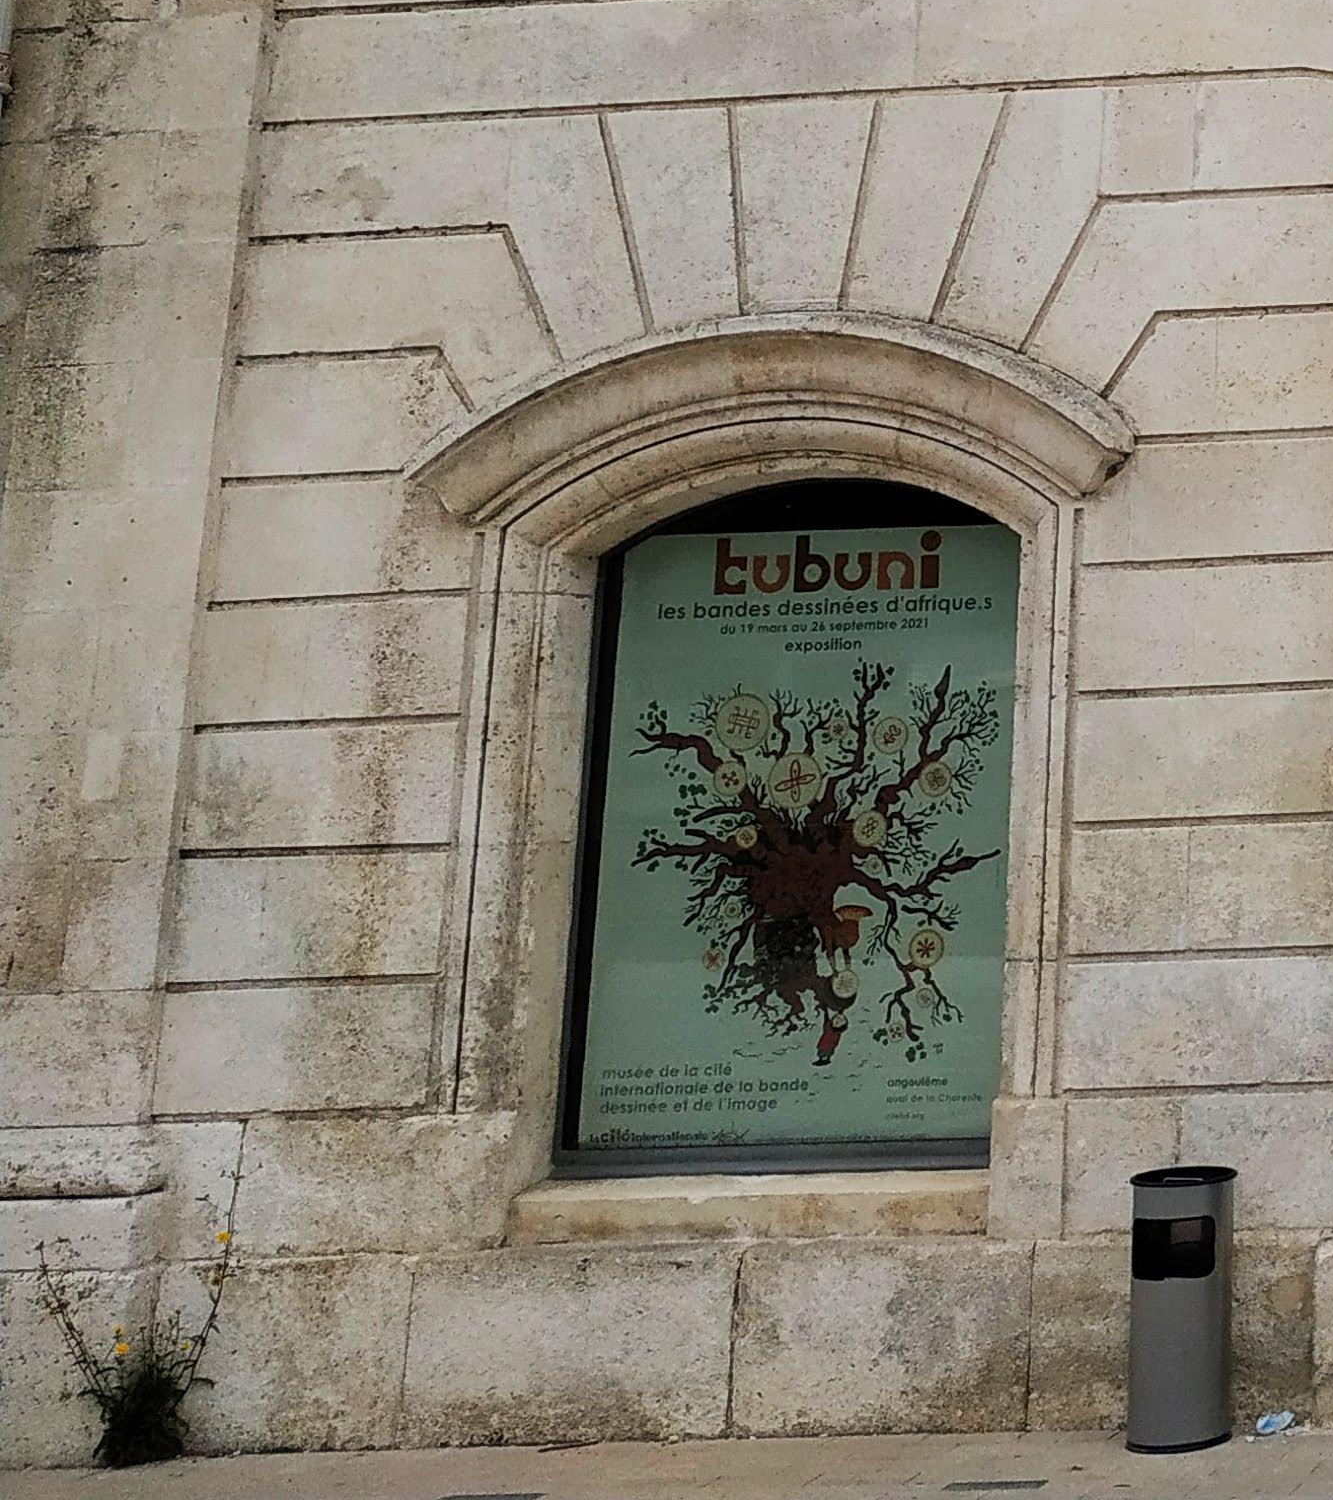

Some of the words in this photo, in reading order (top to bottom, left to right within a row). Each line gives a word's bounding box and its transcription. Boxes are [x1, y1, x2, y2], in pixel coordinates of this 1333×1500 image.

[657, 603, 687, 620] les
[694, 600, 770, 619] bandes
[777, 595, 879, 617] dessinées
[886, 594, 992, 616] d'afrique.s
[720, 623, 735, 635] du
[740, 622, 754, 634] 19
[757, 622, 788, 633] mars
[791, 622, 807, 633] au
[811, 620, 825, 632] 26
[829, 618, 897, 633] septembre
[900, 618, 929, 629] 2021
[784, 637, 862, 654] exposition
[602, 1063, 654, 1080] musée
[659, 1064, 680, 1078] de
[684, 1064, 699, 1077] la
[704, 1062, 733, 1077] cité
[600, 1081, 708, 1097] internationale
[713, 1080, 734, 1094] de
[738, 1080, 753, 1093] la
[758, 1078, 809, 1092] bande
[887, 1076, 948, 1089] angoulême
[600, 1098, 668, 1115] dessinée
[673, 1099, 688, 1113] et
[692, 1098, 713, 1112] de
[718, 1097, 778, 1113] l'image
